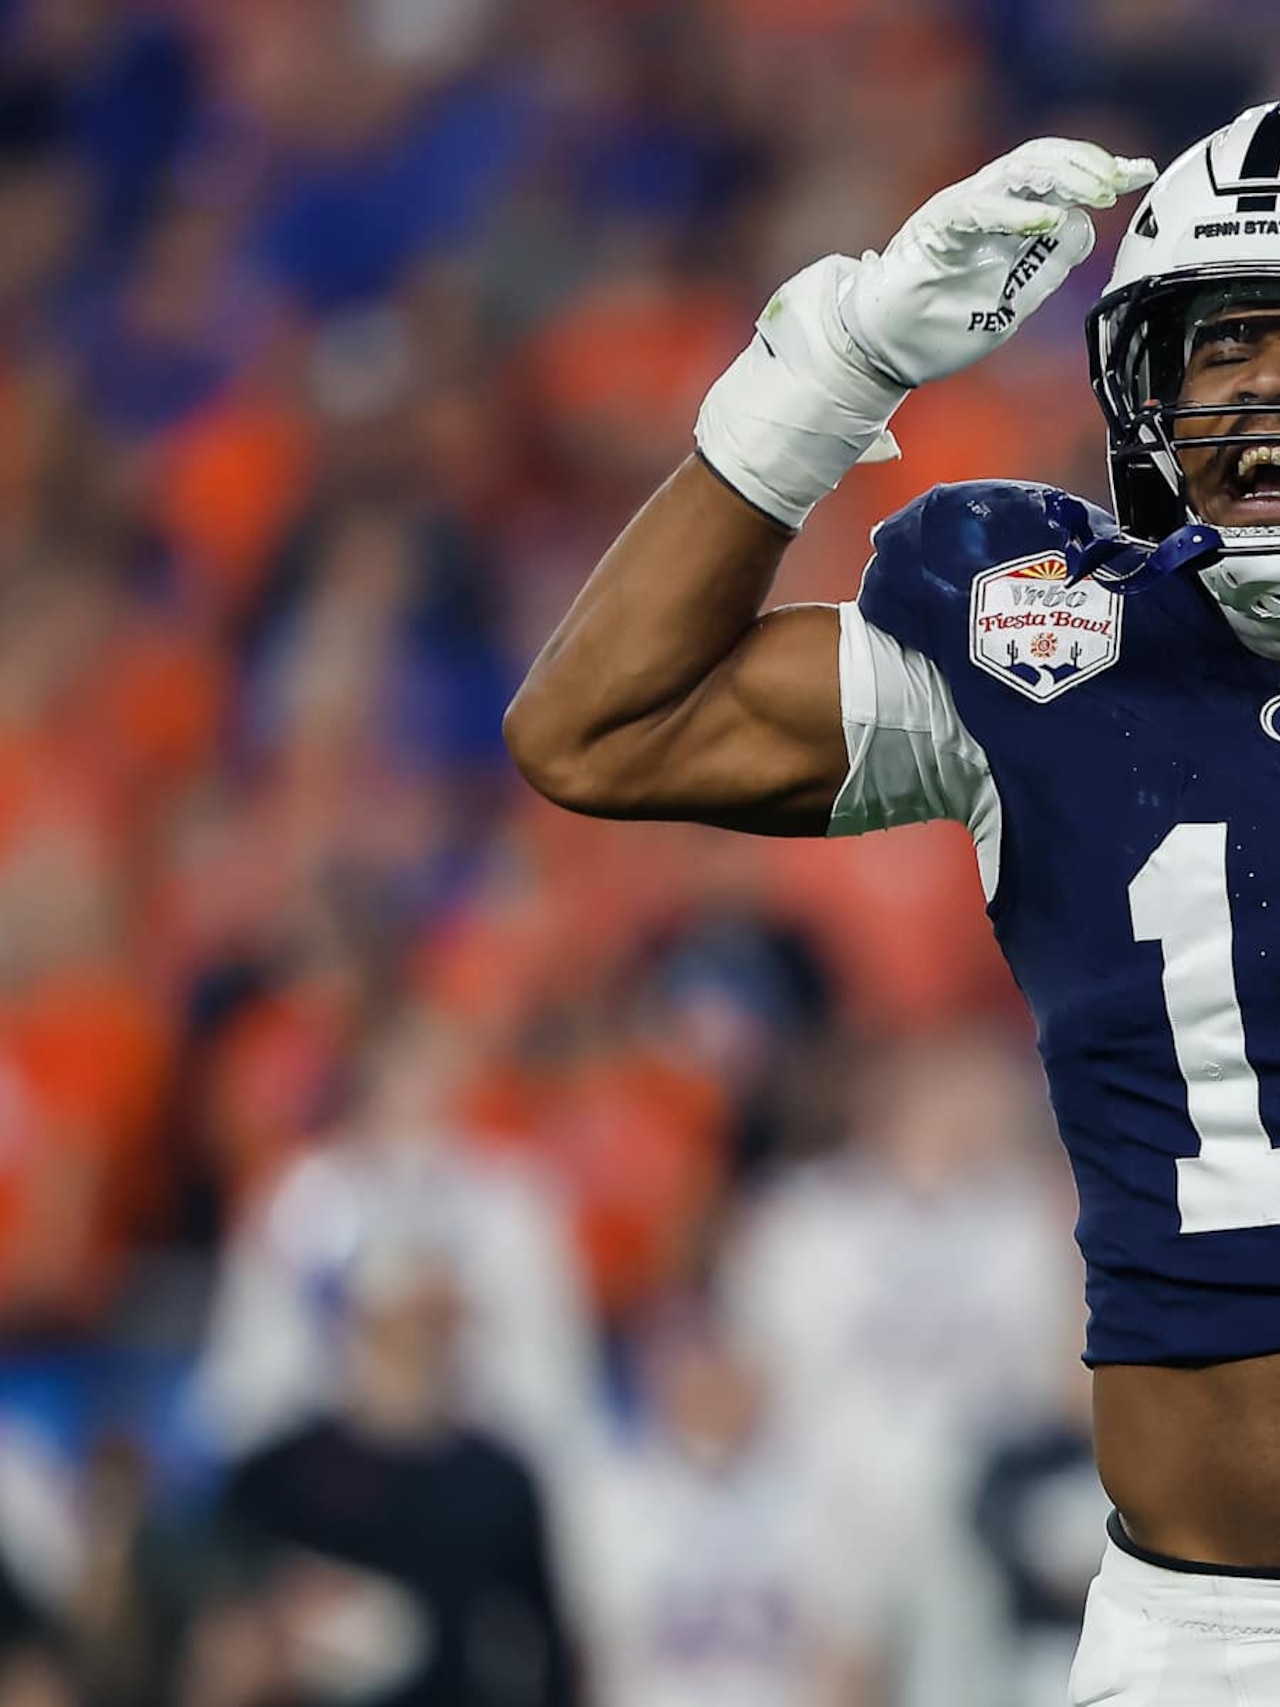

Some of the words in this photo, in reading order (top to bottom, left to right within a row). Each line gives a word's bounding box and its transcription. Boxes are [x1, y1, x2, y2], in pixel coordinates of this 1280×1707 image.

[1194, 221, 1240, 239] PENN
[1003, 234, 1060, 301] STATE
[1010, 583, 1087, 608] Vrbo
[978, 611, 1046, 633] Fiesta
[1050, 611, 1112, 635] Bowl
